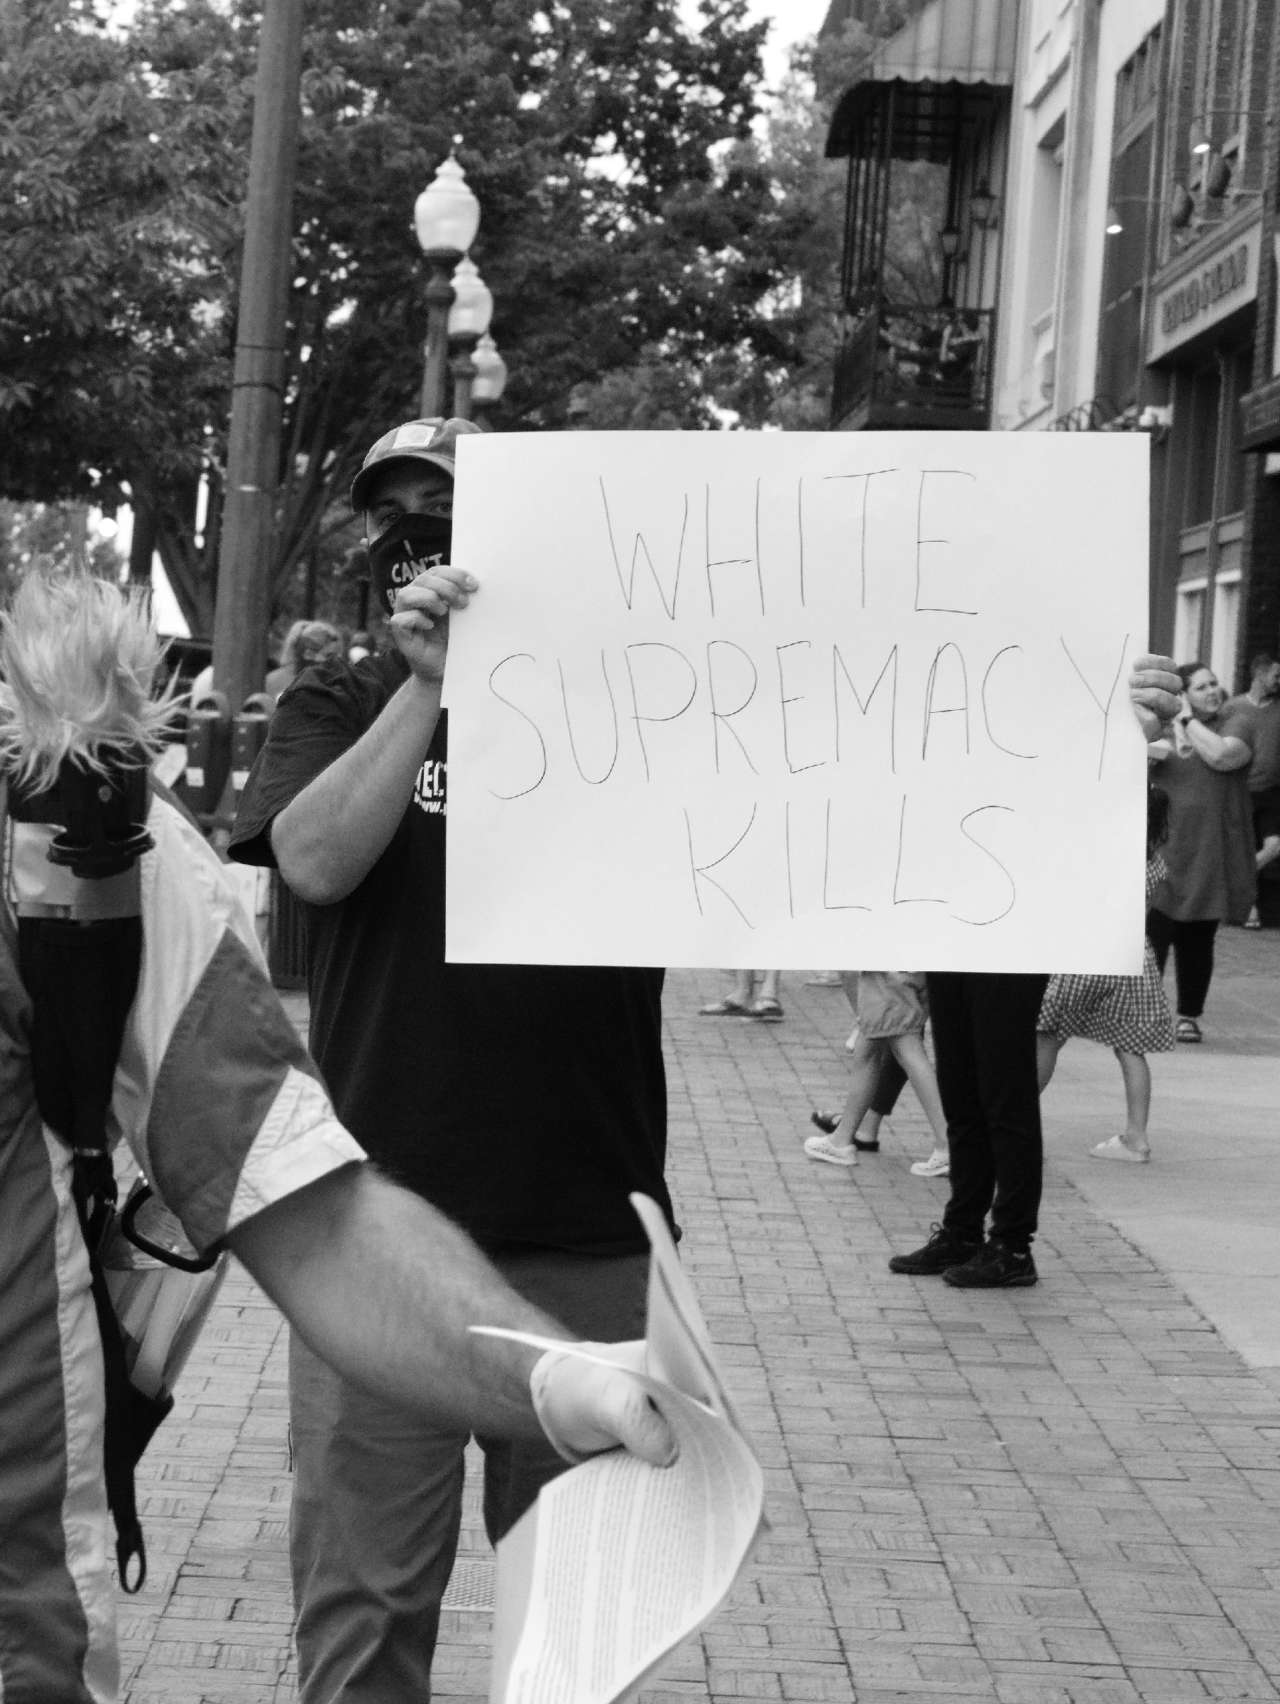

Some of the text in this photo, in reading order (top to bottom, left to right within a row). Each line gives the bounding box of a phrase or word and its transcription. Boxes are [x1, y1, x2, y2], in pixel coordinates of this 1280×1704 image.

[599, 468, 980, 622] WHITE
[488, 633, 1131, 801] SUPREMACY
[683, 794, 1017, 930] KILLS
